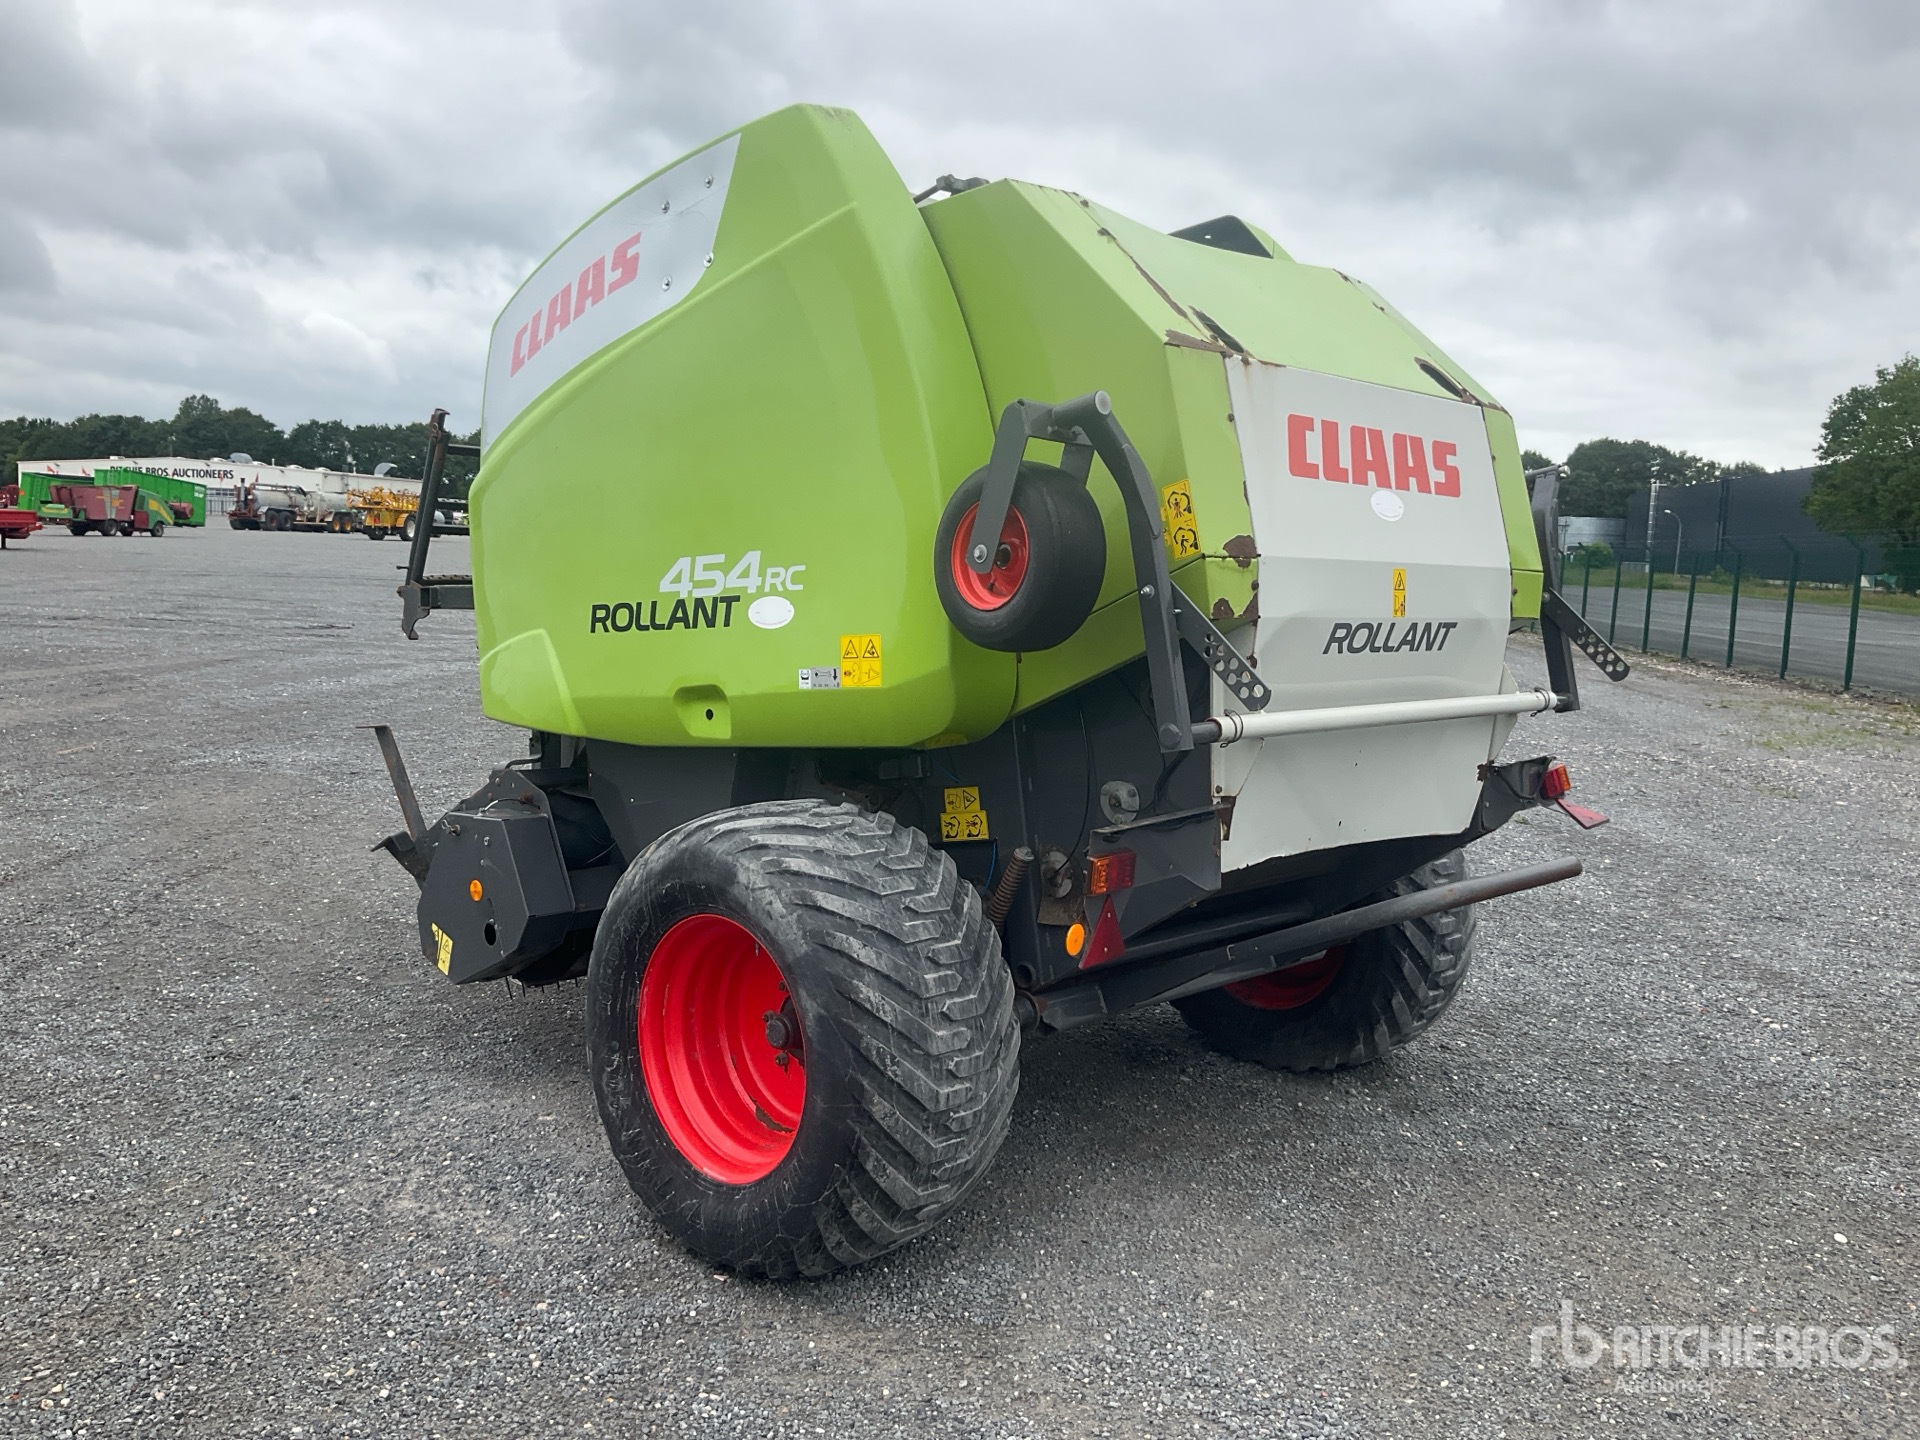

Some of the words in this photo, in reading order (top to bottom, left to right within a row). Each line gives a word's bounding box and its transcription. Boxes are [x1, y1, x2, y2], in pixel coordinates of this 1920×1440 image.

[510, 231, 642, 378] CLAAS
[172, 468, 234, 479] AUCTIONEERS
[1288, 413, 1461, 498] CLAAS
[590, 595, 740, 633] ROLLANT
[1322, 621, 1458, 655] ROLLANT
